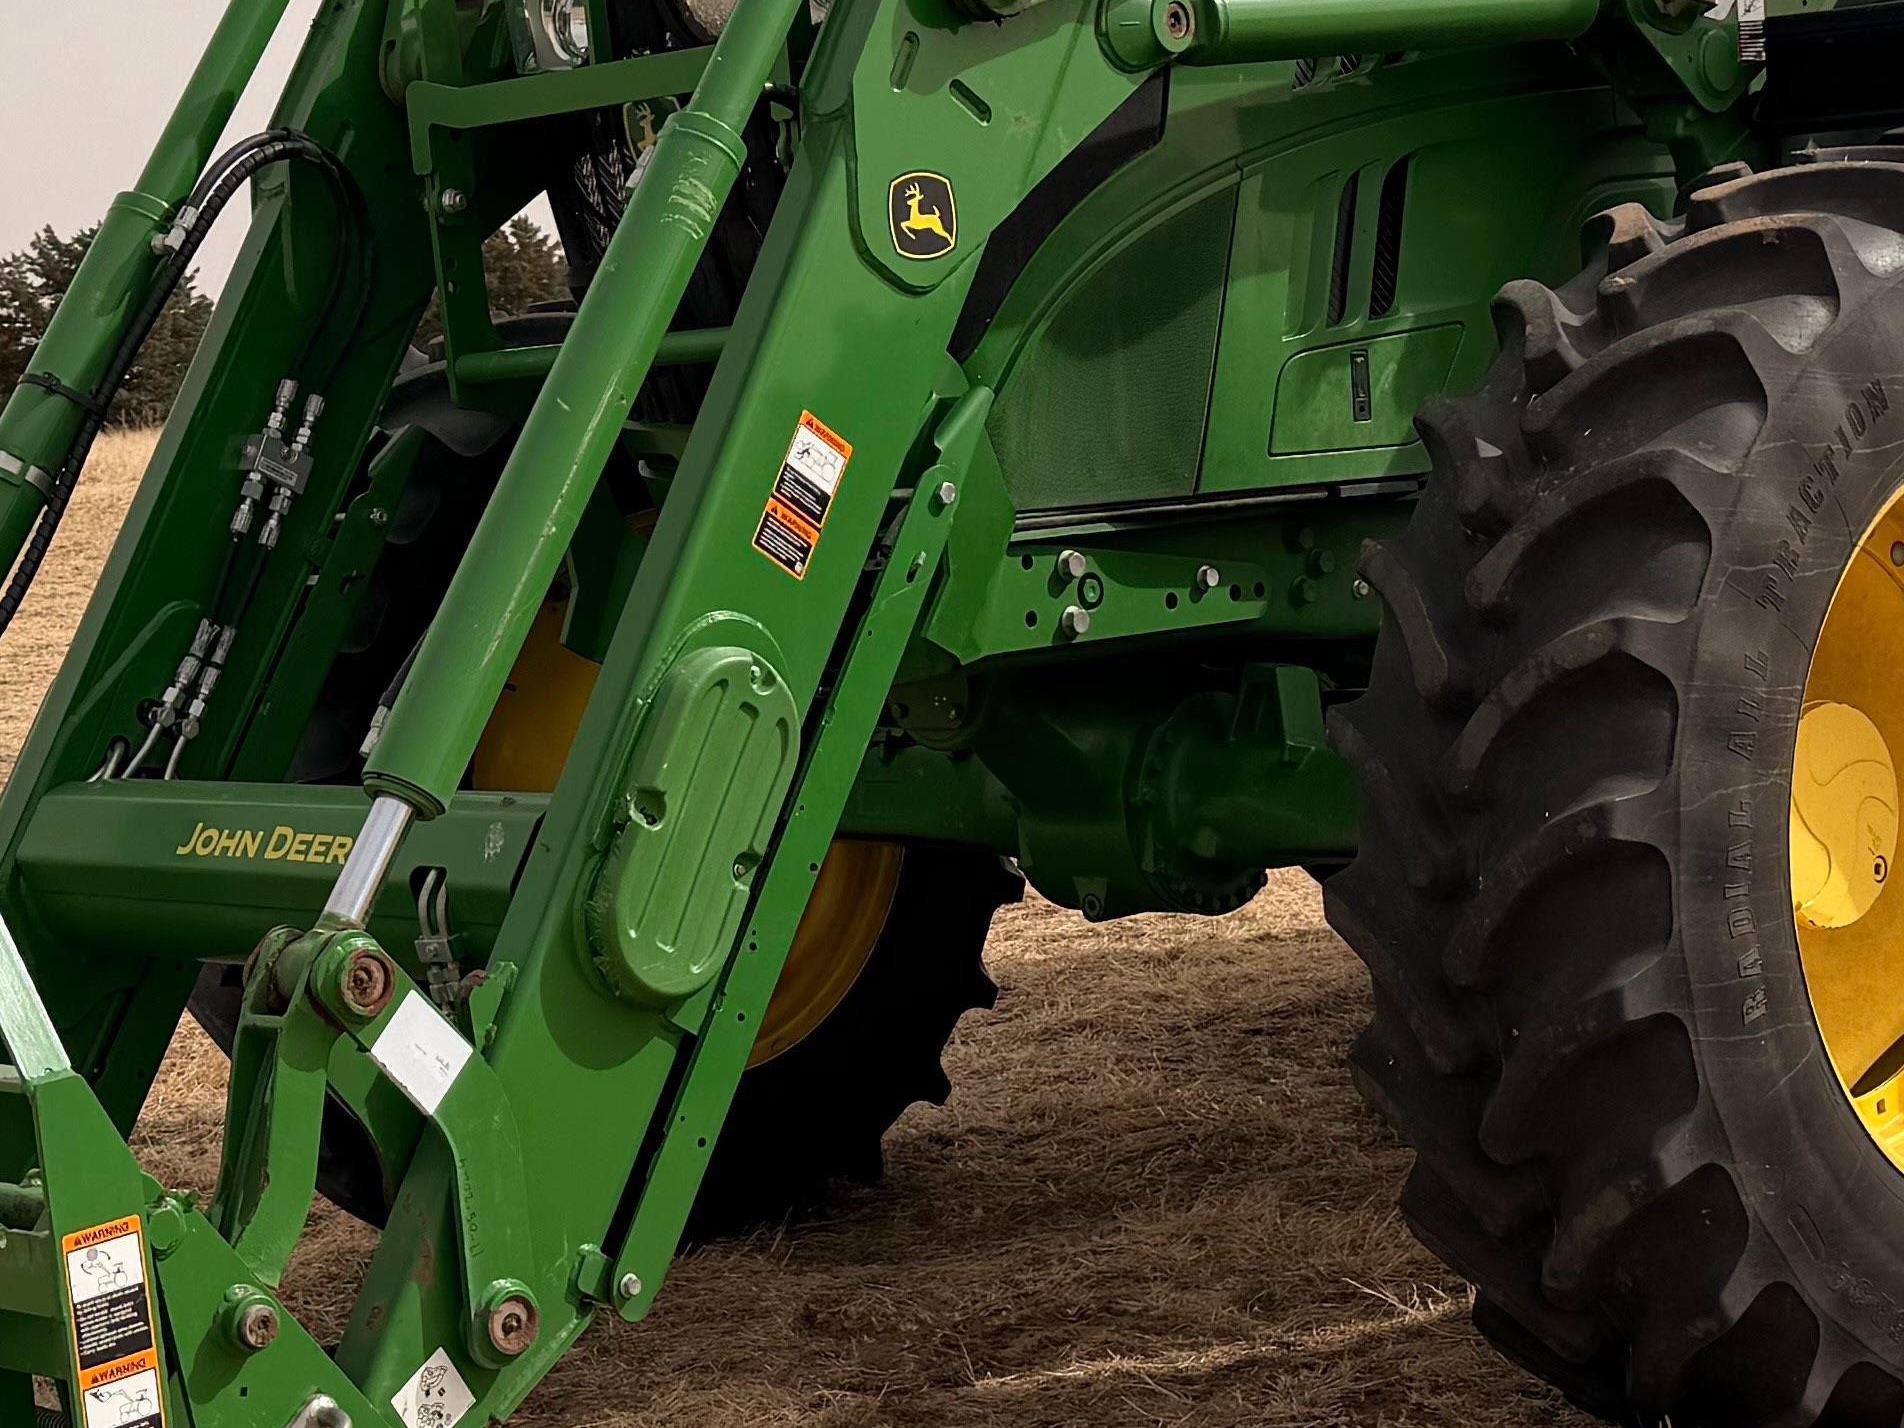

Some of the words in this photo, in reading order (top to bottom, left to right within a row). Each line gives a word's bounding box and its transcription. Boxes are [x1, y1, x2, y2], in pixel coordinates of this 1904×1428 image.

[1721, 799, 1769, 1026] RADIAL
[1753, 377, 1891, 613] TRACTION
[176, 822, 264, 858] JOHN
[264, 825, 354, 865] DEER
[80, 1221, 130, 1245] WARNING
[98, 1358, 147, 1384] WARNING
